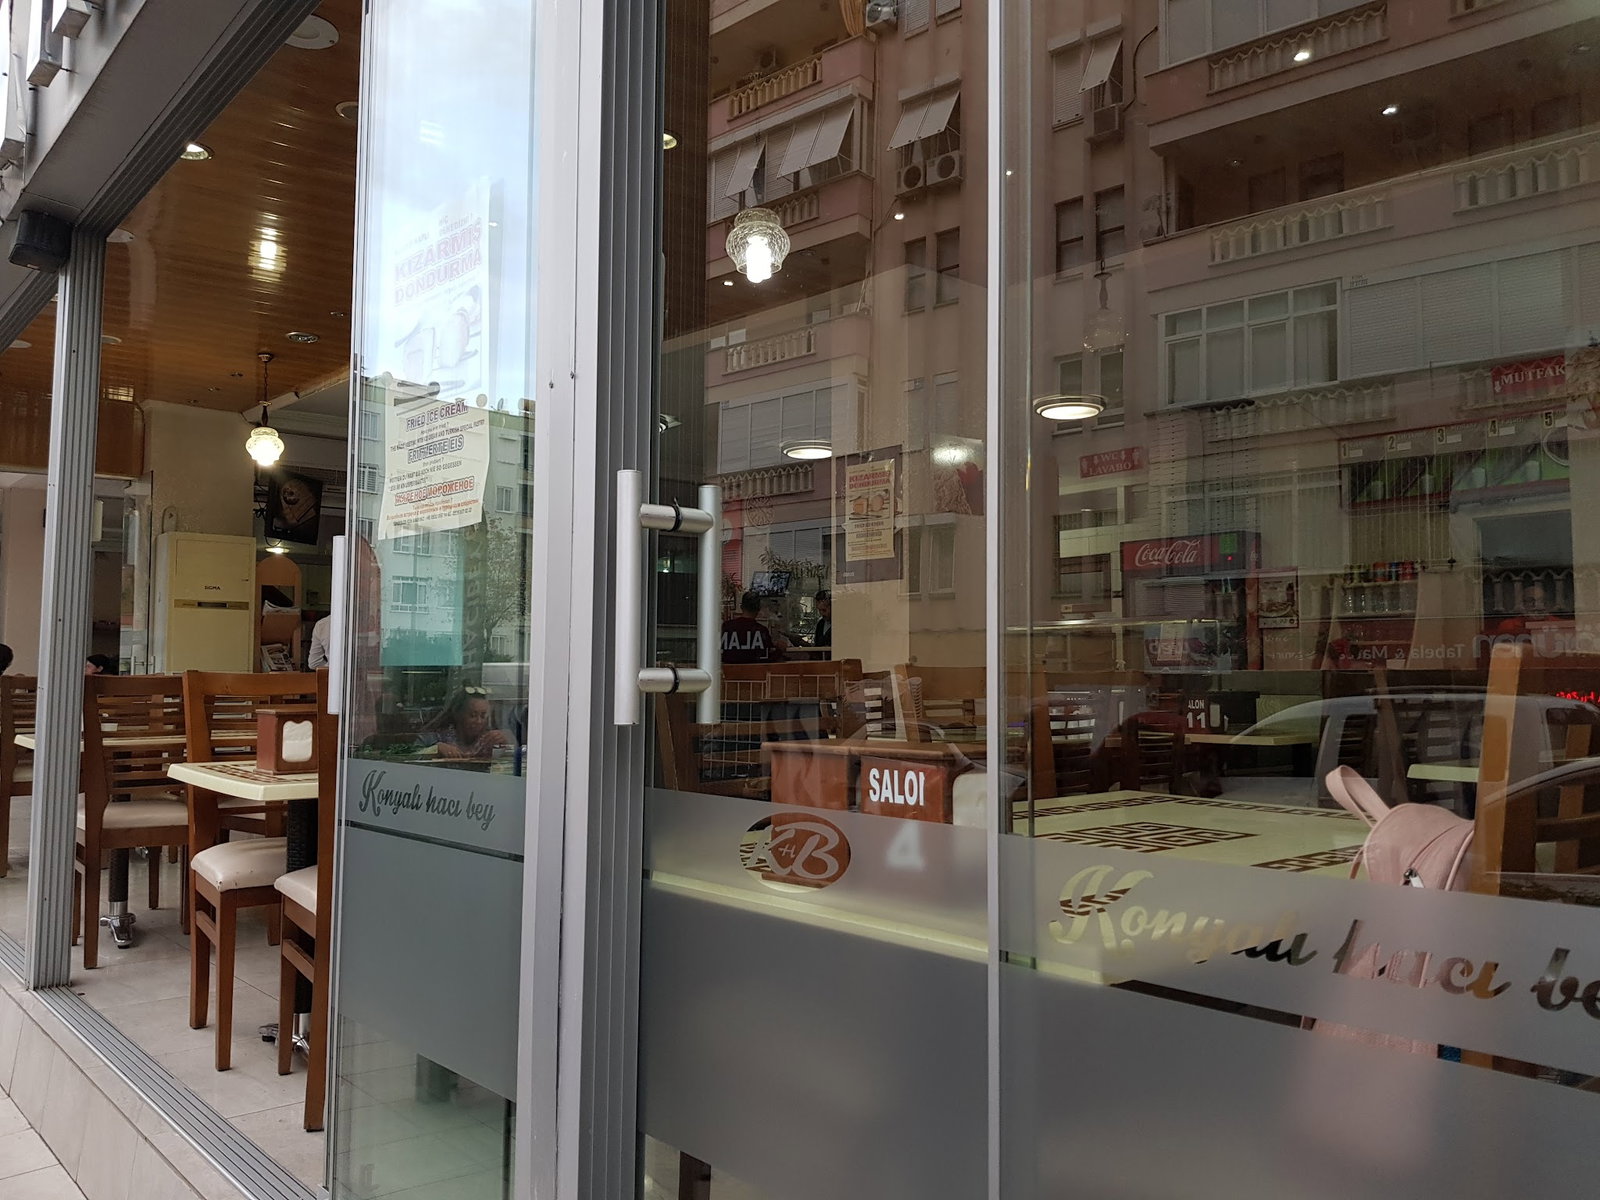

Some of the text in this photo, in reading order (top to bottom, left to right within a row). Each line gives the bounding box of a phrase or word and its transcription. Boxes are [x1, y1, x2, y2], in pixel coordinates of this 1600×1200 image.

[394, 248, 481, 304] DONDURMA
[1500, 365, 1565, 385] MUTFAK
[406, 414, 425, 431] FRIED
[426, 409, 438, 425] ICE
[439, 402, 468, 420] CREAM
[1544, 411, 1552, 426] 5
[1490, 420, 1497, 434] 4
[1388, 436, 1395, 450] 2
[1437, 428, 1445, 443] 3
[449, 435, 464, 452] EIS
[1342, 443, 1347, 457] 1
[1100, 452, 1119, 461] WC
[1089, 462, 1132, 475] LAVABO
[1135, 539, 1201, 567] Coca-Cola
[1187, 699, 1205, 709] ALON
[1186, 712, 1206, 728] 11
[358, 769, 495, 831] Konyalı hacı bey
[1048, 864, 1600, 1020] Konyalı hacı be
